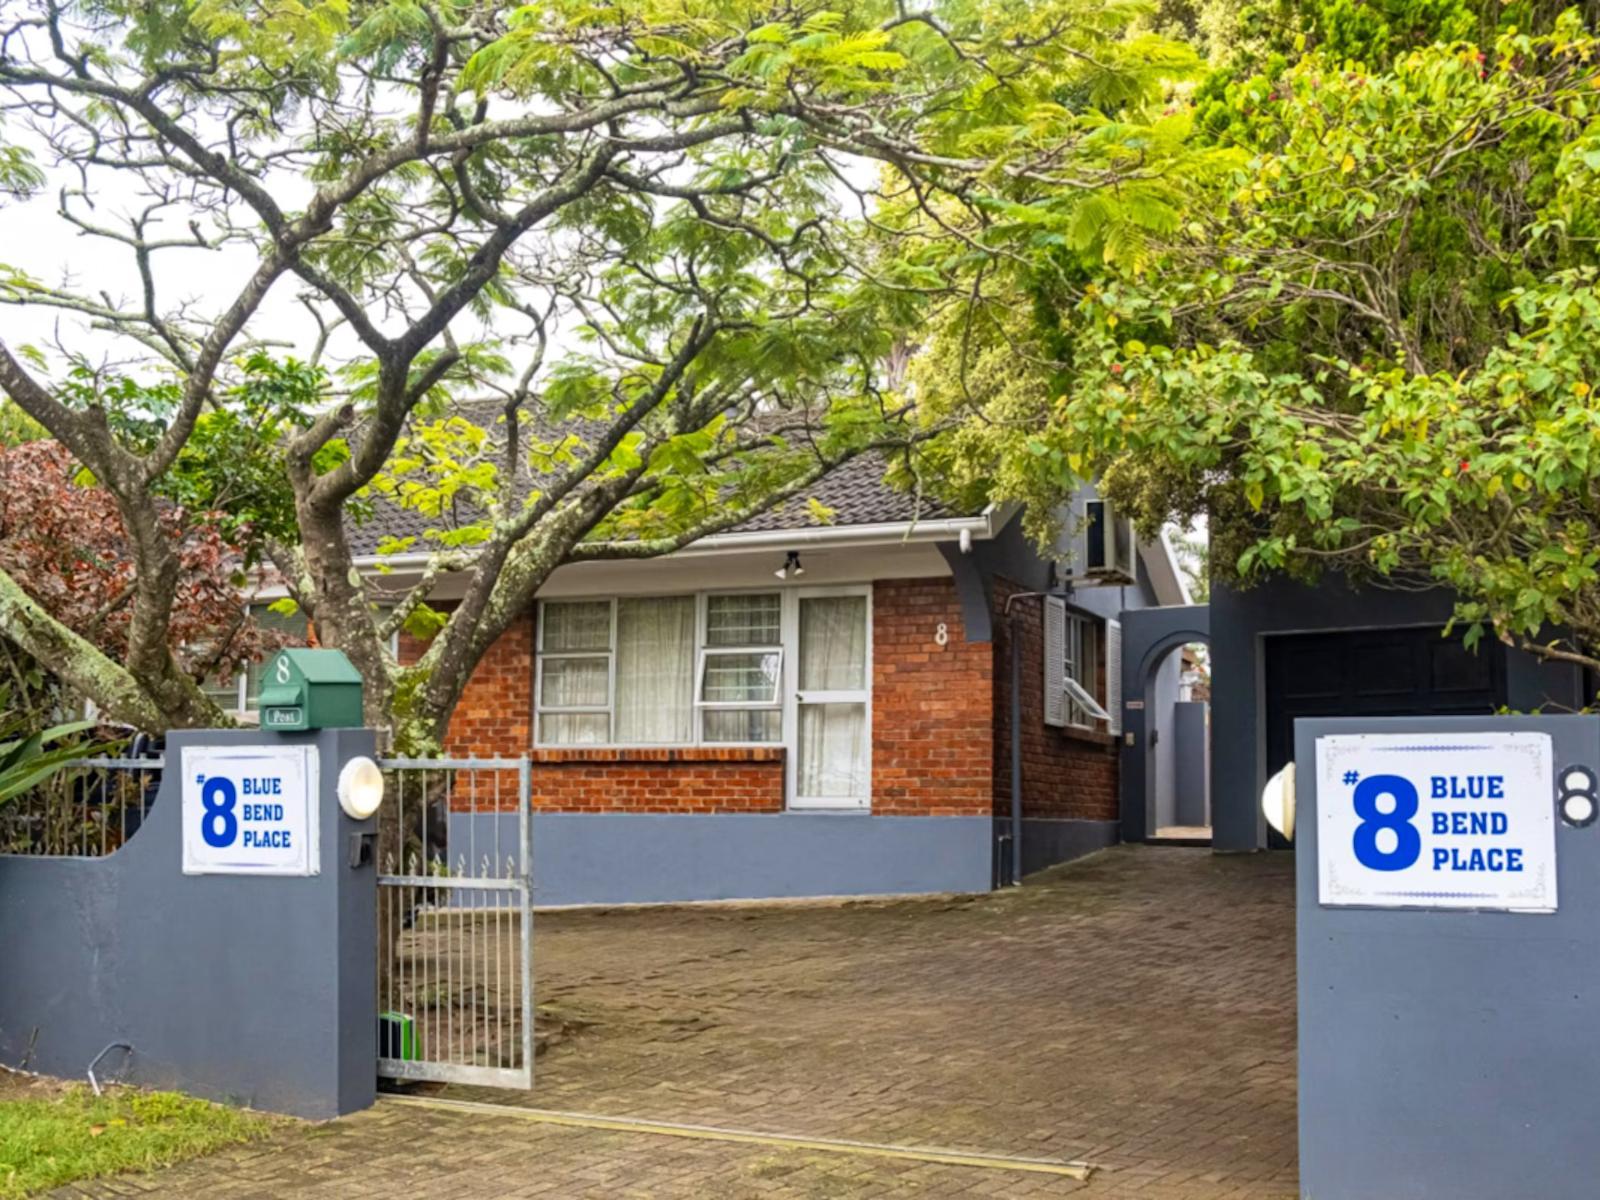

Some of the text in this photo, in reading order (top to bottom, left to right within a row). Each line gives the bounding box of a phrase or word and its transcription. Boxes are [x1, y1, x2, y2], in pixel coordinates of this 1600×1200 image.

[935, 622, 948, 646] 8
[276, 655, 290, 684] 8
[242, 777, 281, 795] BLUE
[1431, 775, 1504, 799] BLUE
[1558, 764, 1599, 829] 8
[243, 804, 284, 821] BEND
[1431, 811, 1508, 835] BEND
[243, 830, 292, 848] PLACE
[1432, 848, 1524, 872] PLACE
